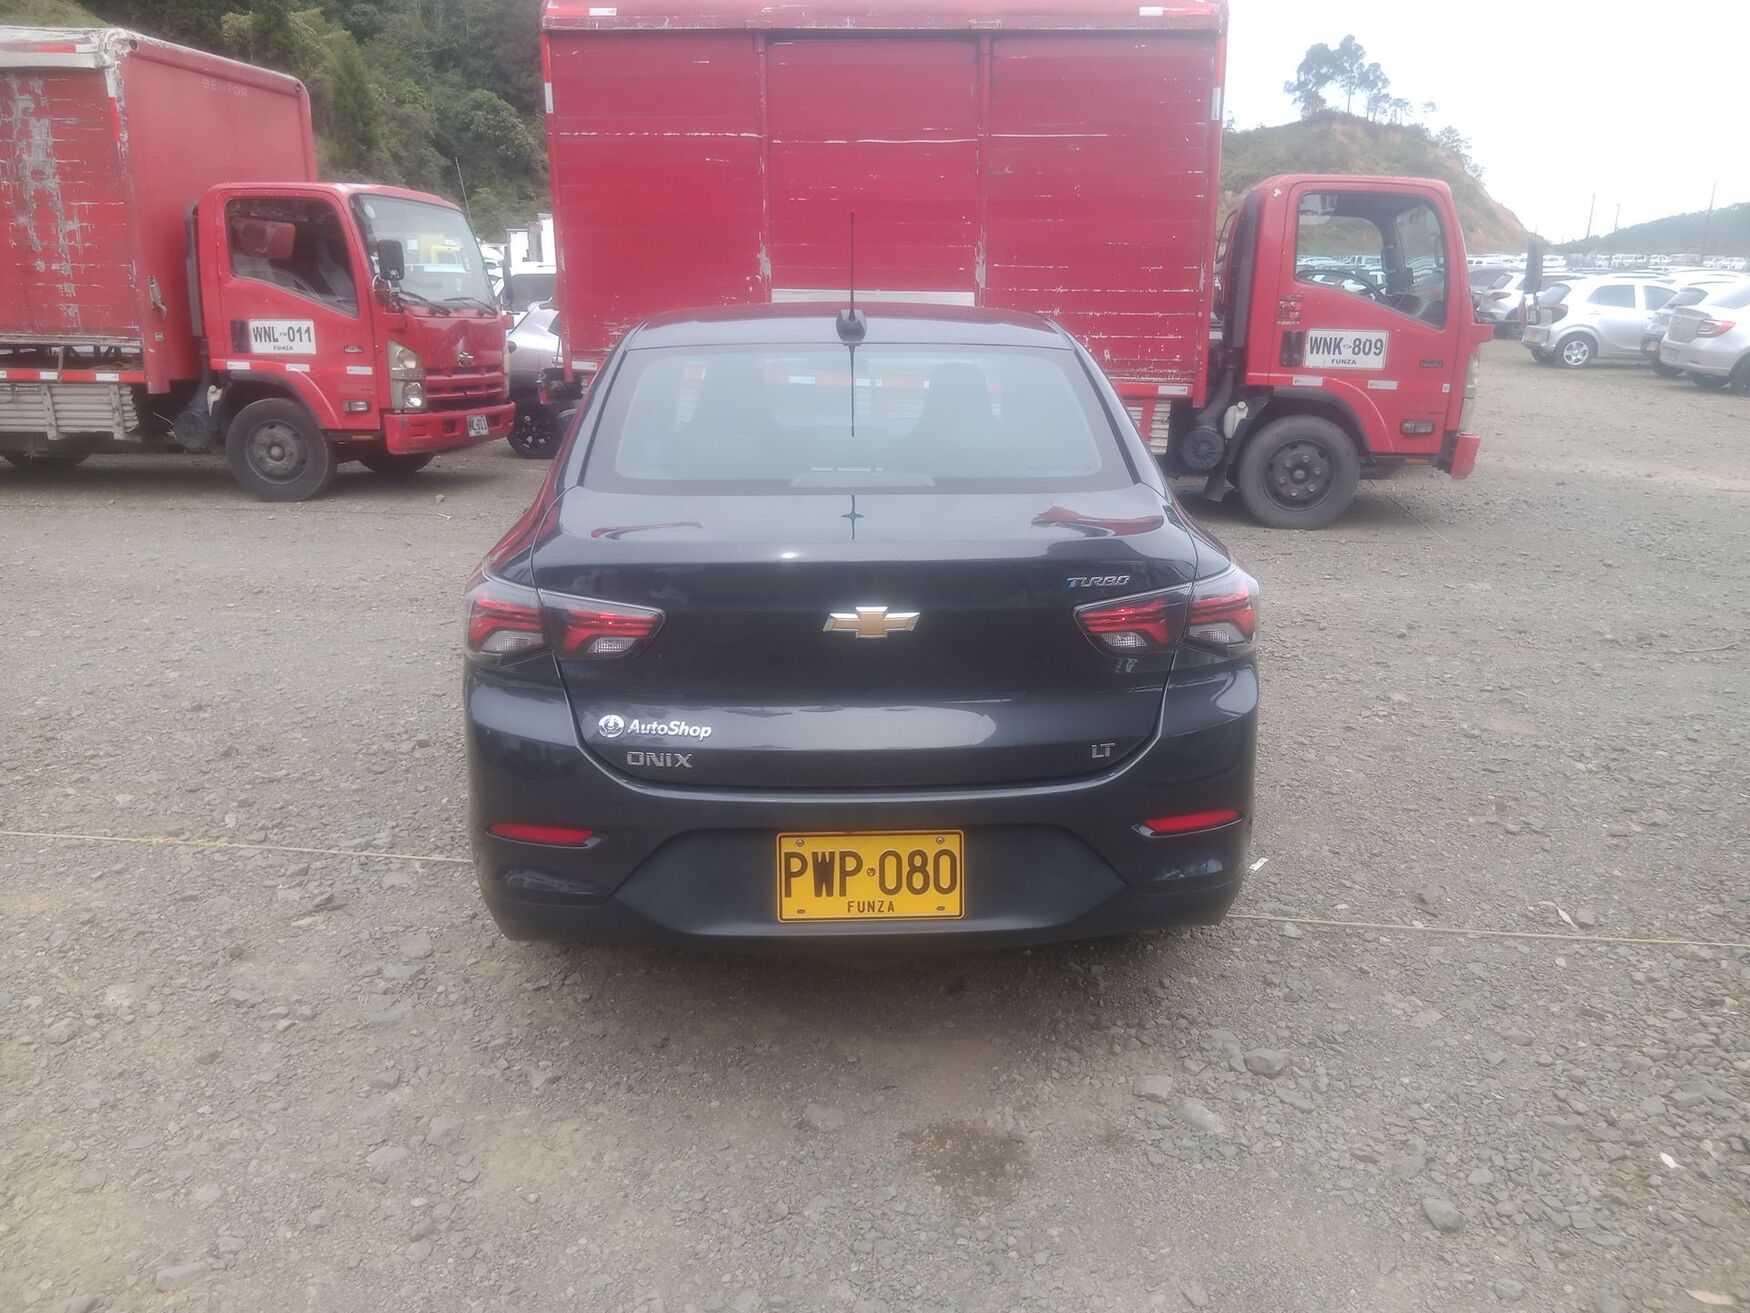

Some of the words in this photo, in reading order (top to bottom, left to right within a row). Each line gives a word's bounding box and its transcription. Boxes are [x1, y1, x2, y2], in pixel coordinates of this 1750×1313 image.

[1066, 575, 1131, 588] TURBO
[627, 718, 712, 741] AutoShop
[1091, 742, 1116, 758] LT
[626, 751, 693, 768] ONIX
[847, 900, 895, 913] FUNZA
